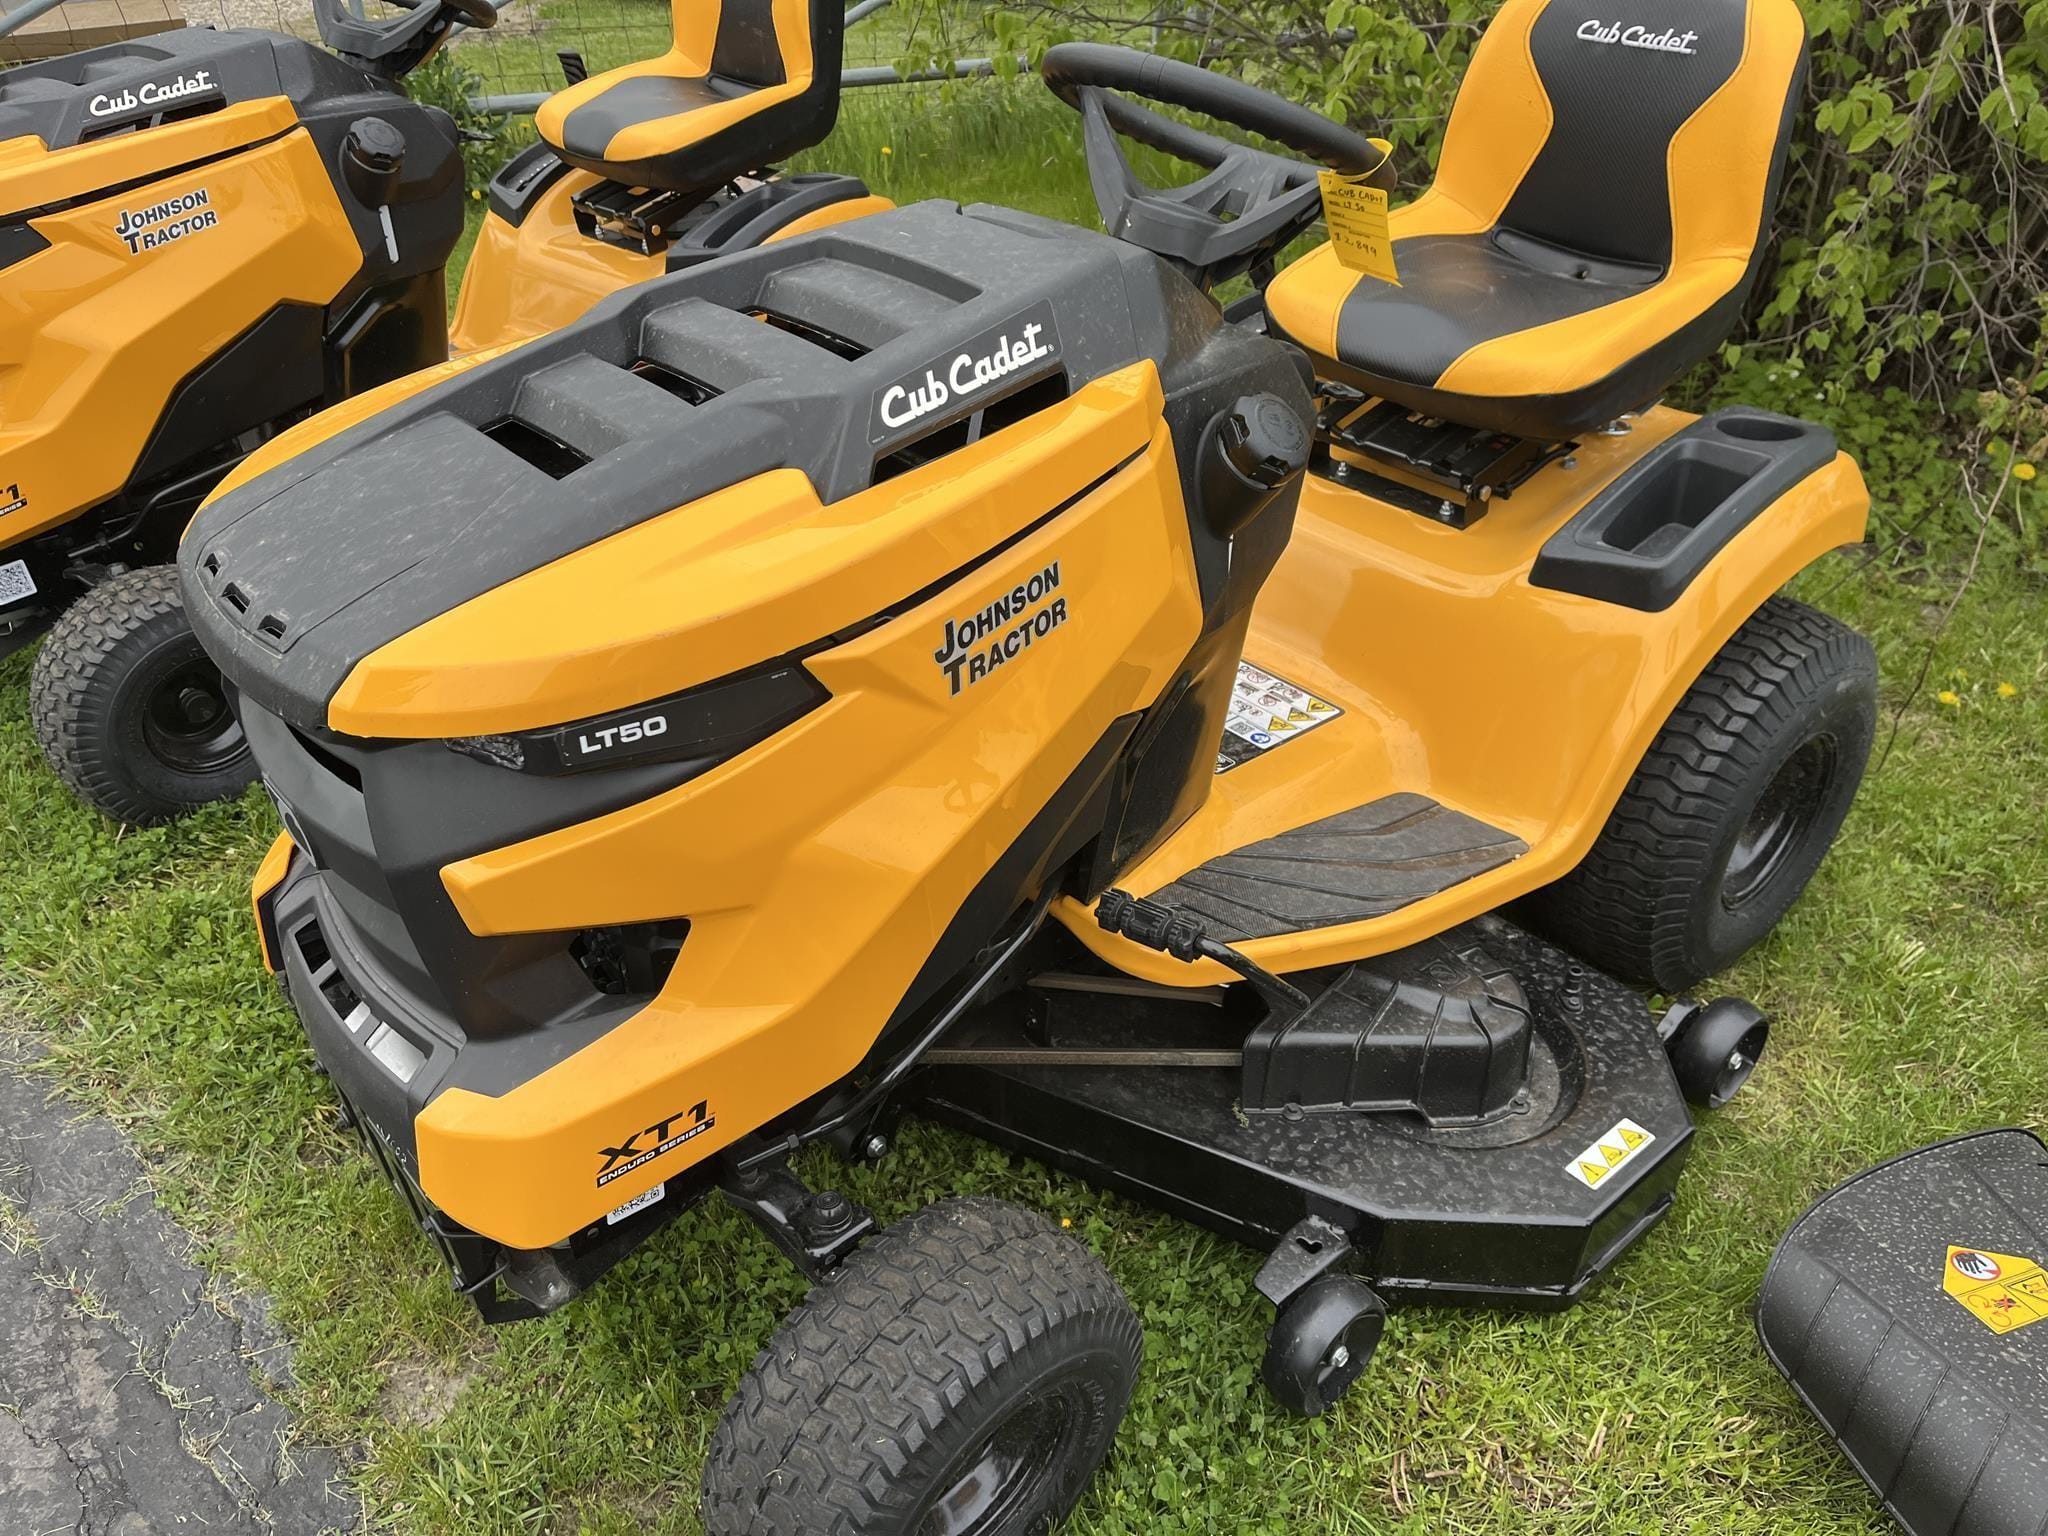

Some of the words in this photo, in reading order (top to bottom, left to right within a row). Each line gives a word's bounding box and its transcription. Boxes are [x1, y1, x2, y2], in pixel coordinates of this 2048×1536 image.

[1576, 19, 1621, 45] Cub
[1620, 25, 1699, 55] Cadet
[89, 89, 139, 117] Cub
[138, 70, 214, 105] Cadet
[115, 188, 208, 235] JOHNSON
[123, 210, 217, 255] TRACTOR
[880, 369, 949, 428] Cub
[949, 322, 1048, 396] Cadet
[934, 561, 1060, 664] JOHNSON
[943, 597, 1067, 696] TRACTOR
[579, 715, 668, 754] LT50
[596, 1099, 708, 1176] XT1
[599, 1151, 656, 1185] ENDURO
[659, 1124, 707, 1152] SERIES
